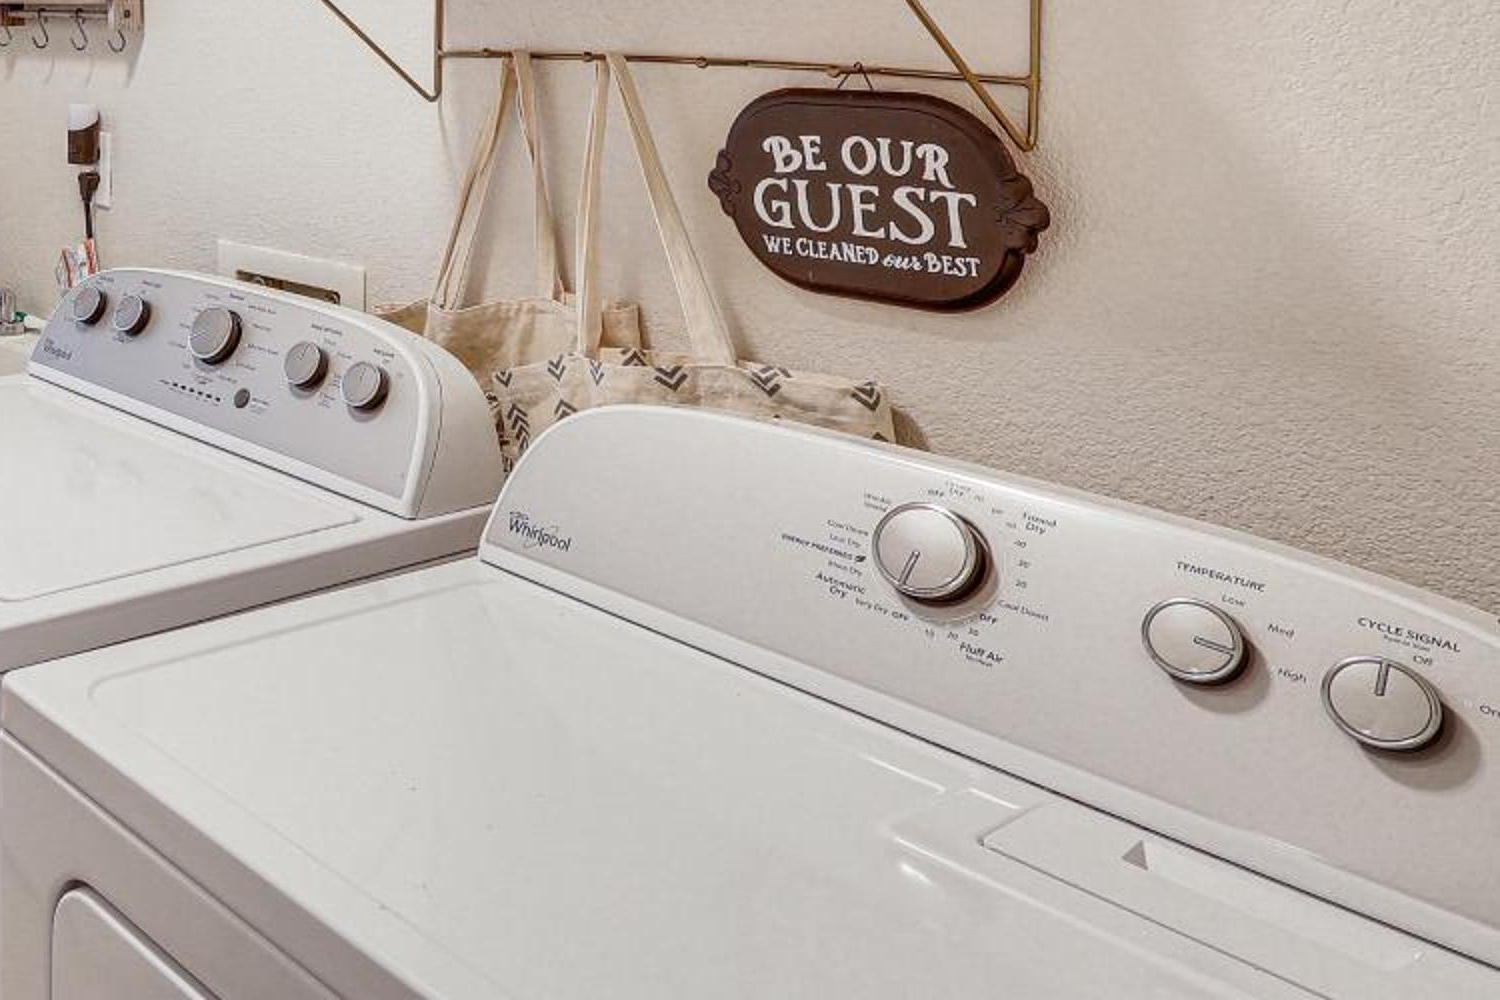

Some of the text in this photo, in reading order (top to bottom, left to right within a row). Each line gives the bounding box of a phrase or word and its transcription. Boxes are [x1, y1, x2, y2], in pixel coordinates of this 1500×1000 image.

[762, 135, 955, 189] BE OUR
[753, 177, 977, 249] GUEST
[762, 234, 981, 278] WE CLEANED our BEST
[509, 516, 573, 552] Whirlpool
[1175, 560, 1267, 593] TEMPERATURE
[1267, 622, 1295, 639] Med
[1357, 616, 1404, 637] CYCLE
[1405, 629, 1461, 653] SIGNAL
[1277, 666, 1307, 685] High
